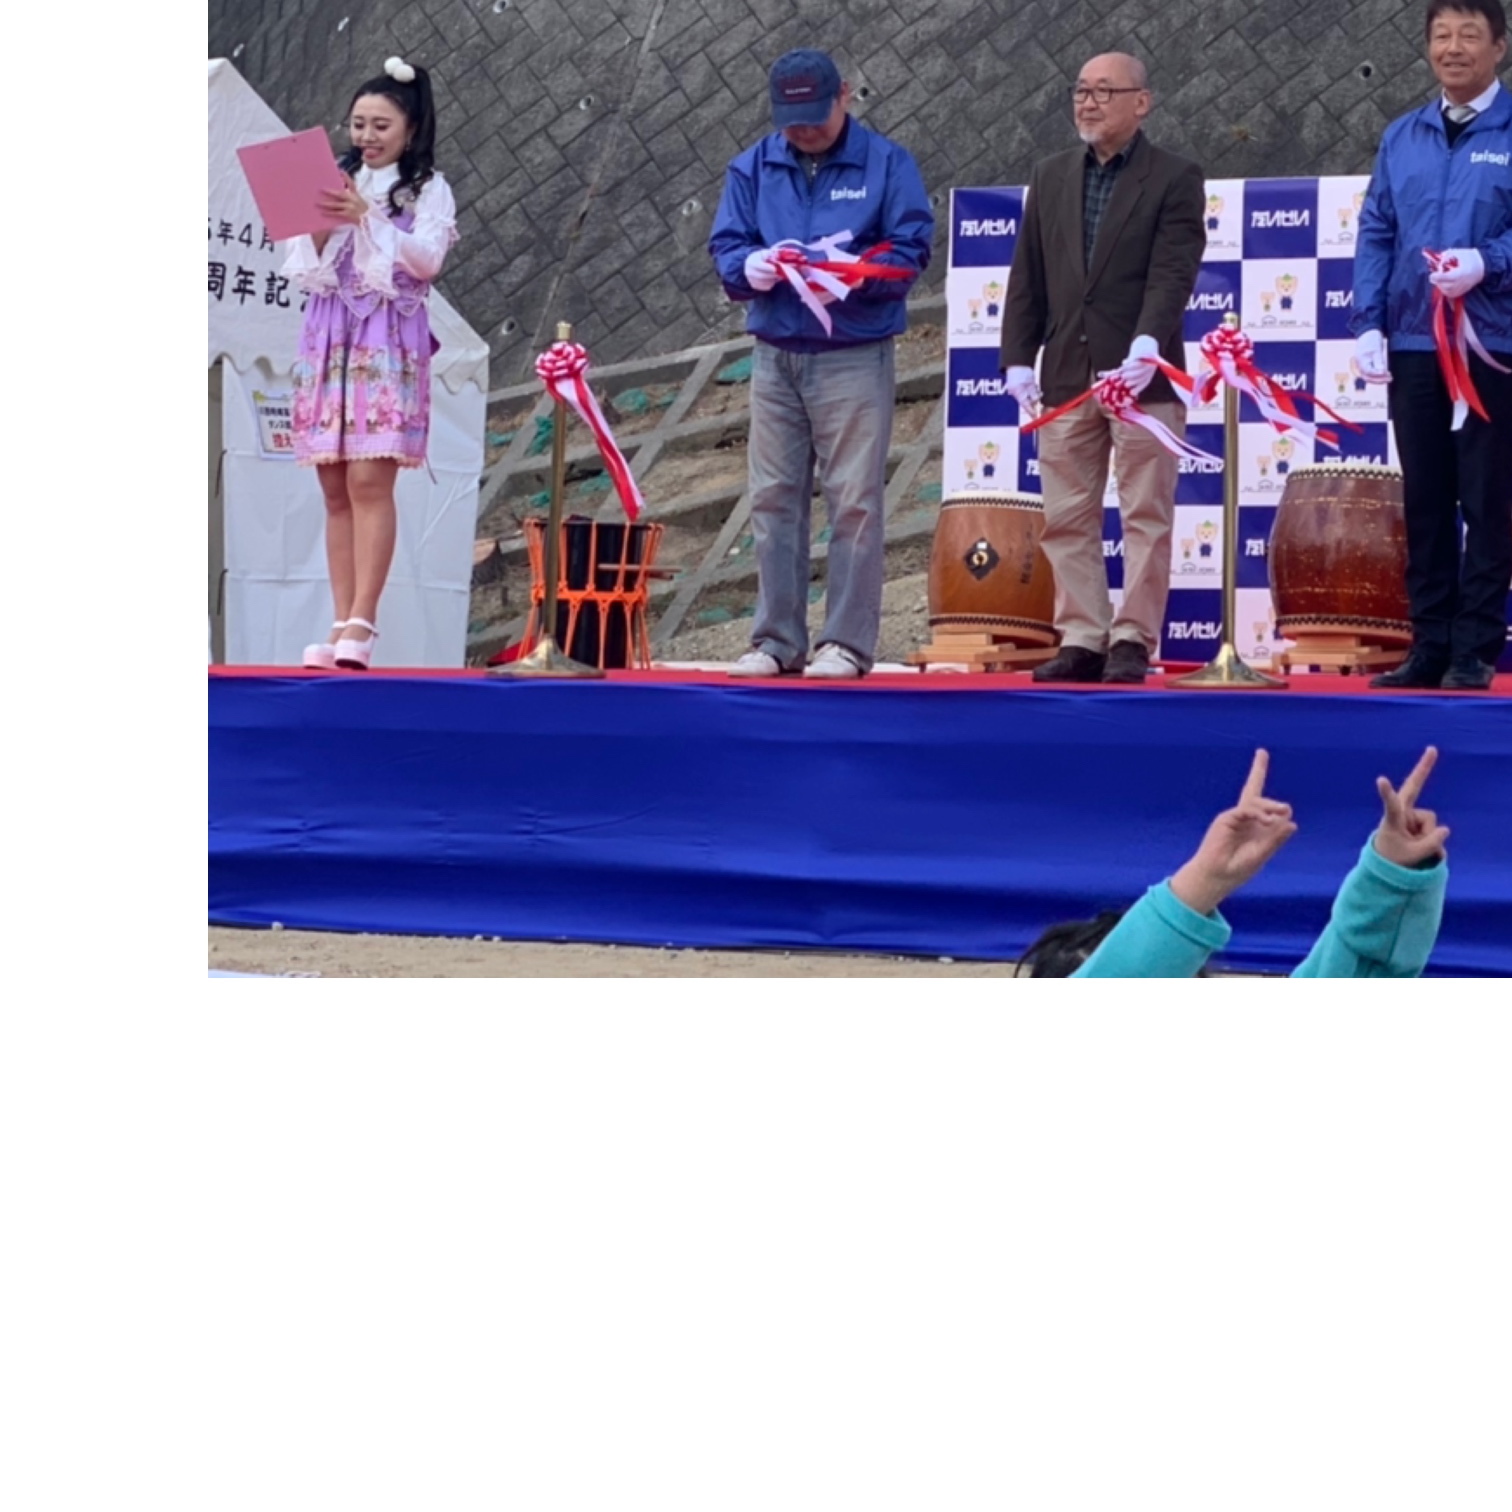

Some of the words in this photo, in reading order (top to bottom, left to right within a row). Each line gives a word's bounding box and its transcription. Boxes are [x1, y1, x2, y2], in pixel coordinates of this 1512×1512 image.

[1470, 149, 1511, 167] taisei
[1251, 209, 1310, 227] たいせい
[960, 218, 1016, 237] たいせい
[1185, 292, 1233, 311] いせい
